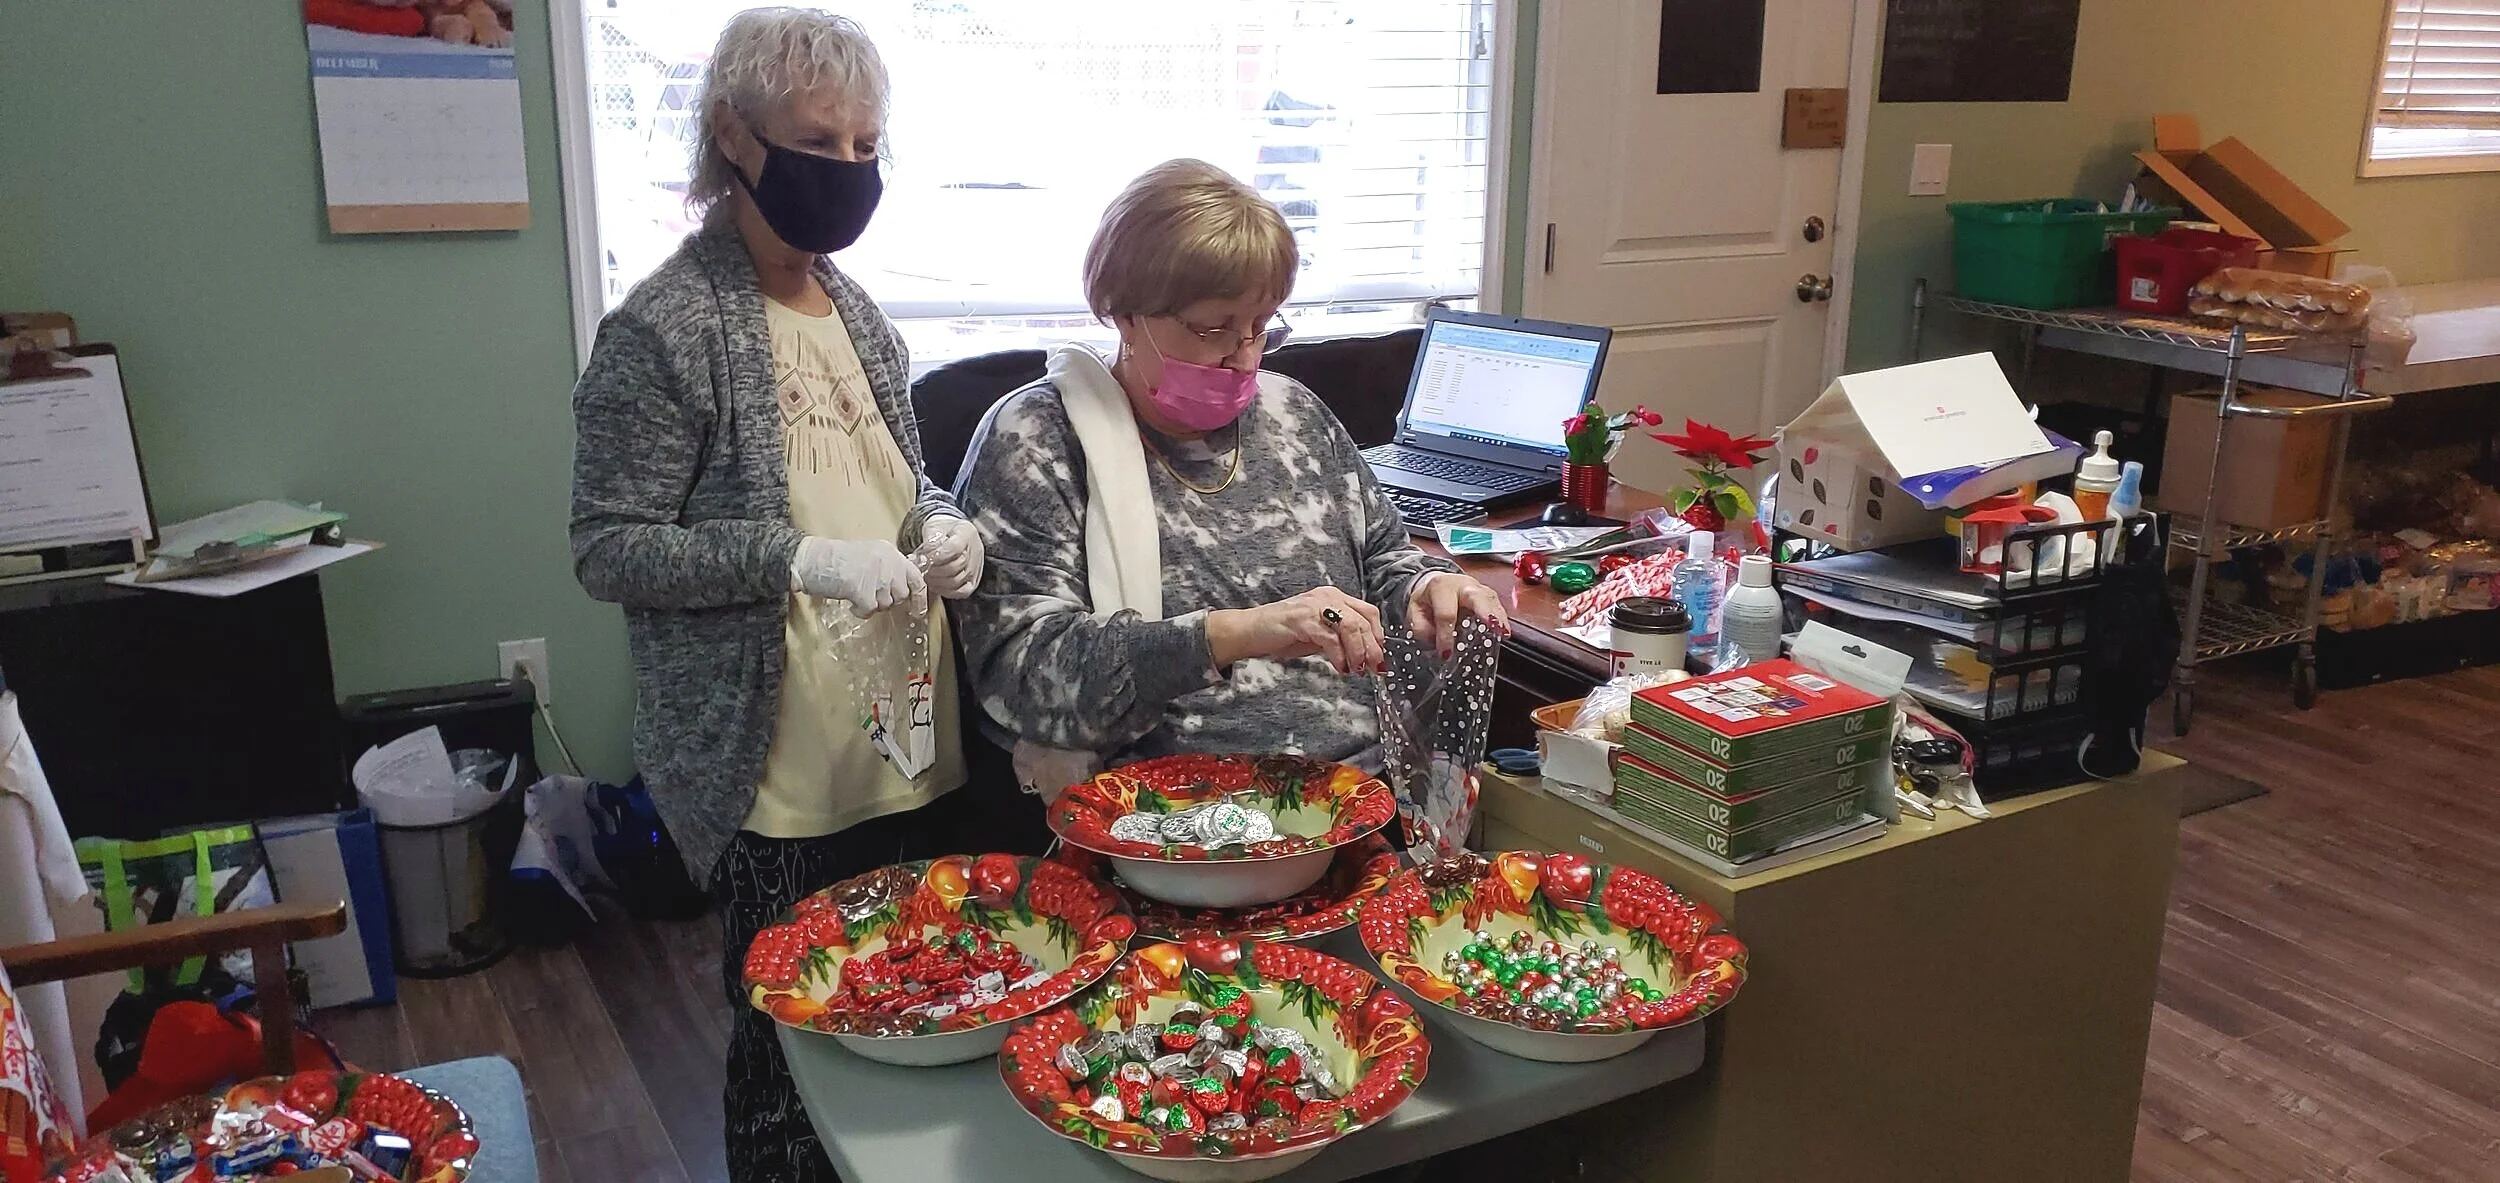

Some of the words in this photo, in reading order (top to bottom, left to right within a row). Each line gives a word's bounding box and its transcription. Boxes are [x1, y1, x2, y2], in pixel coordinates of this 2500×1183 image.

[1844, 714, 1865, 734] 20
[1711, 737, 1731, 760] 20
[1836, 744, 1856, 765] 20
[1705, 769, 1726, 792] 20
[1709, 804, 1730, 826] 20
[1706, 833, 1728, 855] 20
